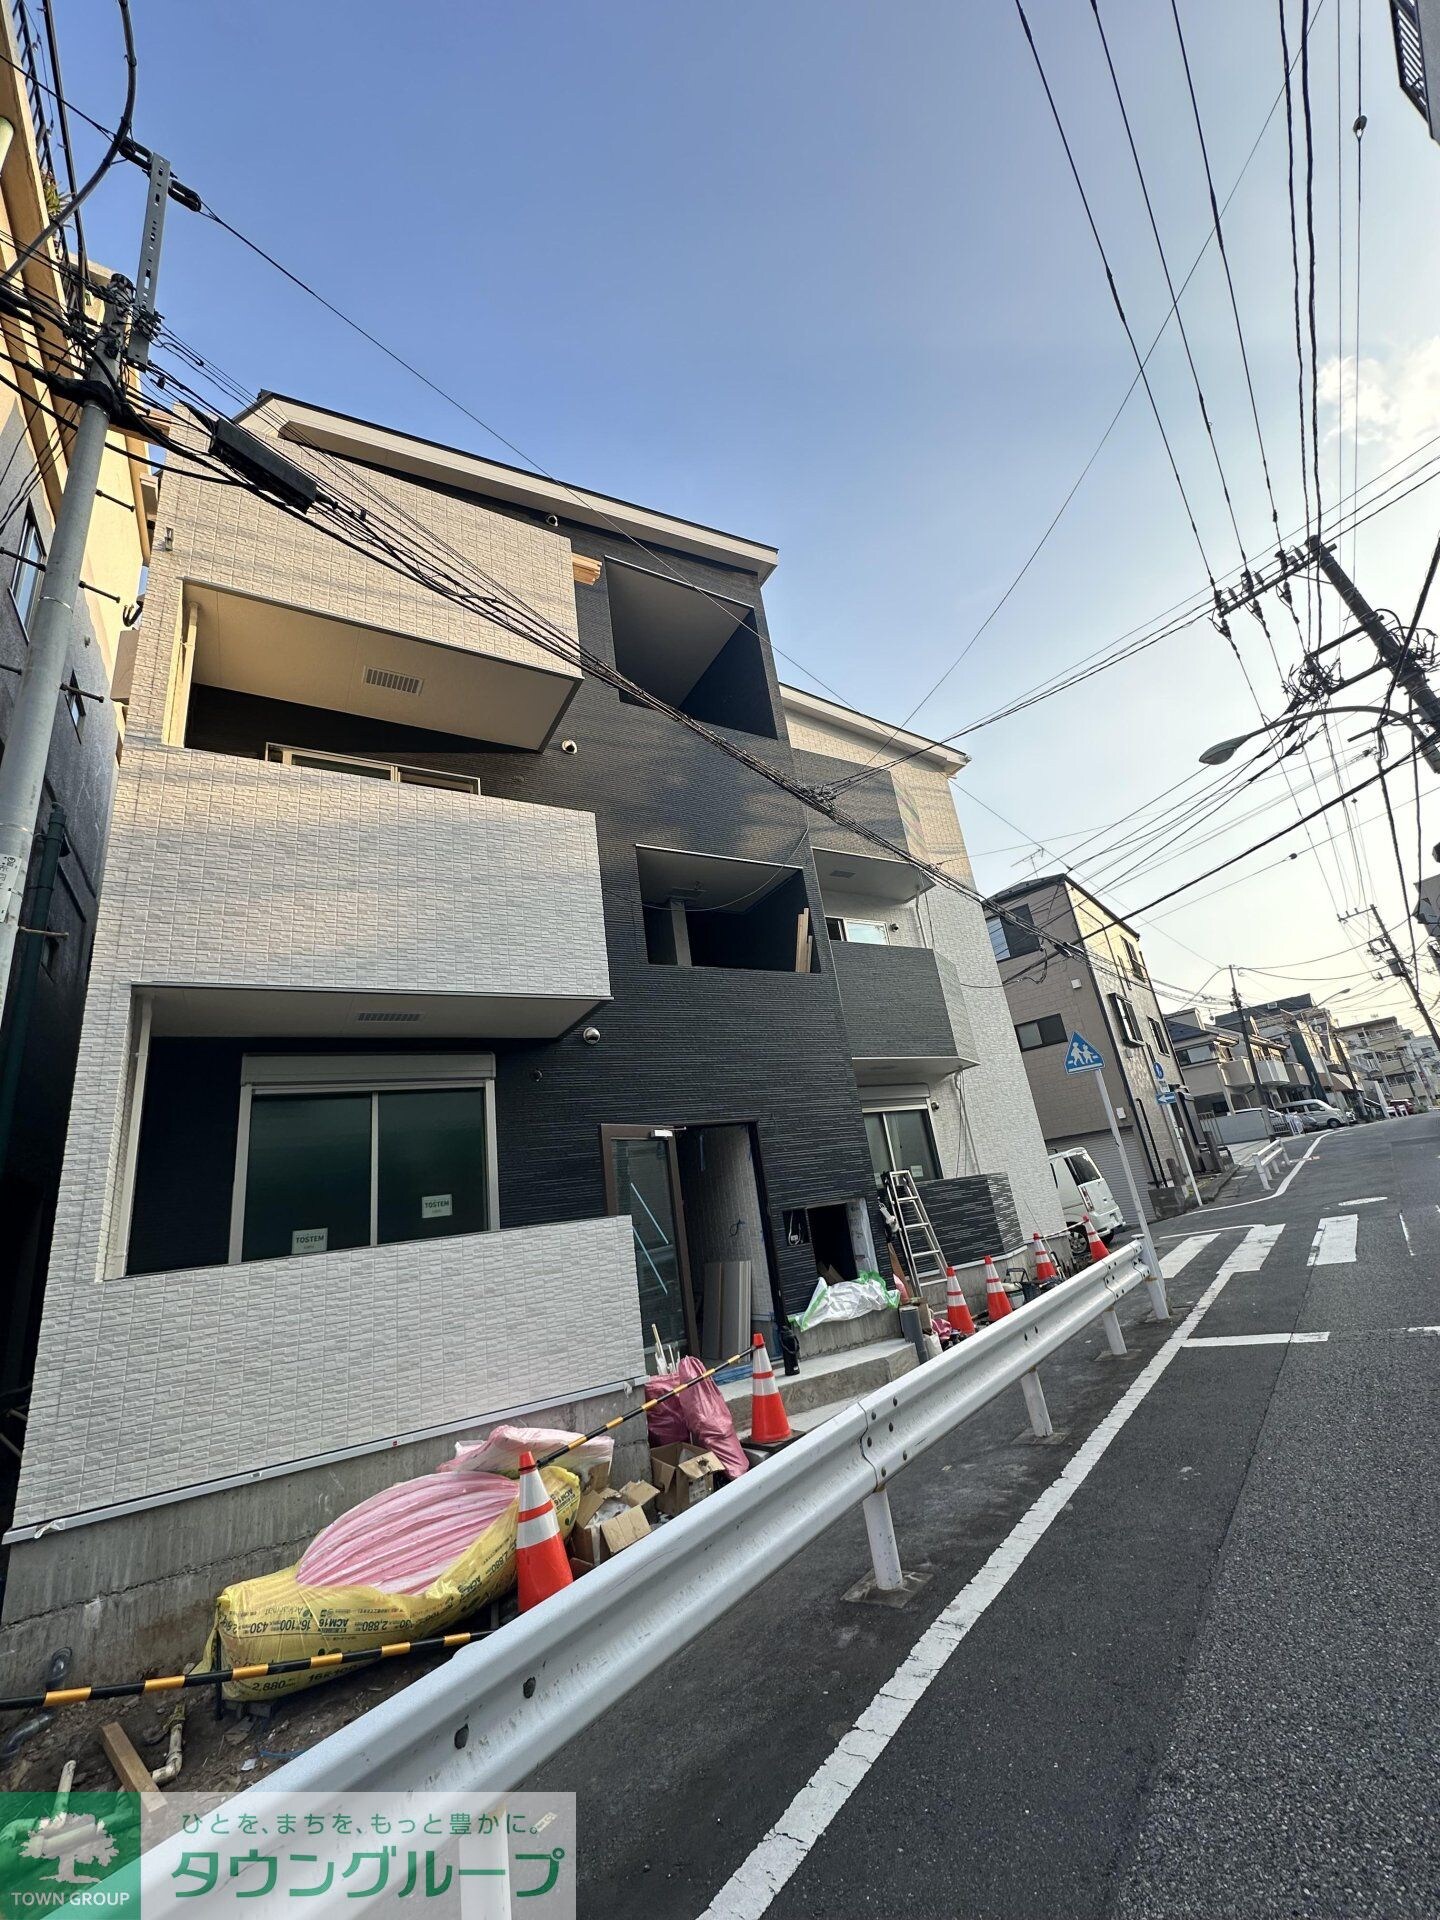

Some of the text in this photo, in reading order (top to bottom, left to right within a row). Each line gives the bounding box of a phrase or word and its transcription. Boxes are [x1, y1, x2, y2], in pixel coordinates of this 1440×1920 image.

[425, 1200, 449, 1209] TOSTEM
[296, 1235, 325, 1244] TOSTEM
[319, 1618, 349, 1628] ACM16
[361, 1621, 388, 1632] 2,880
